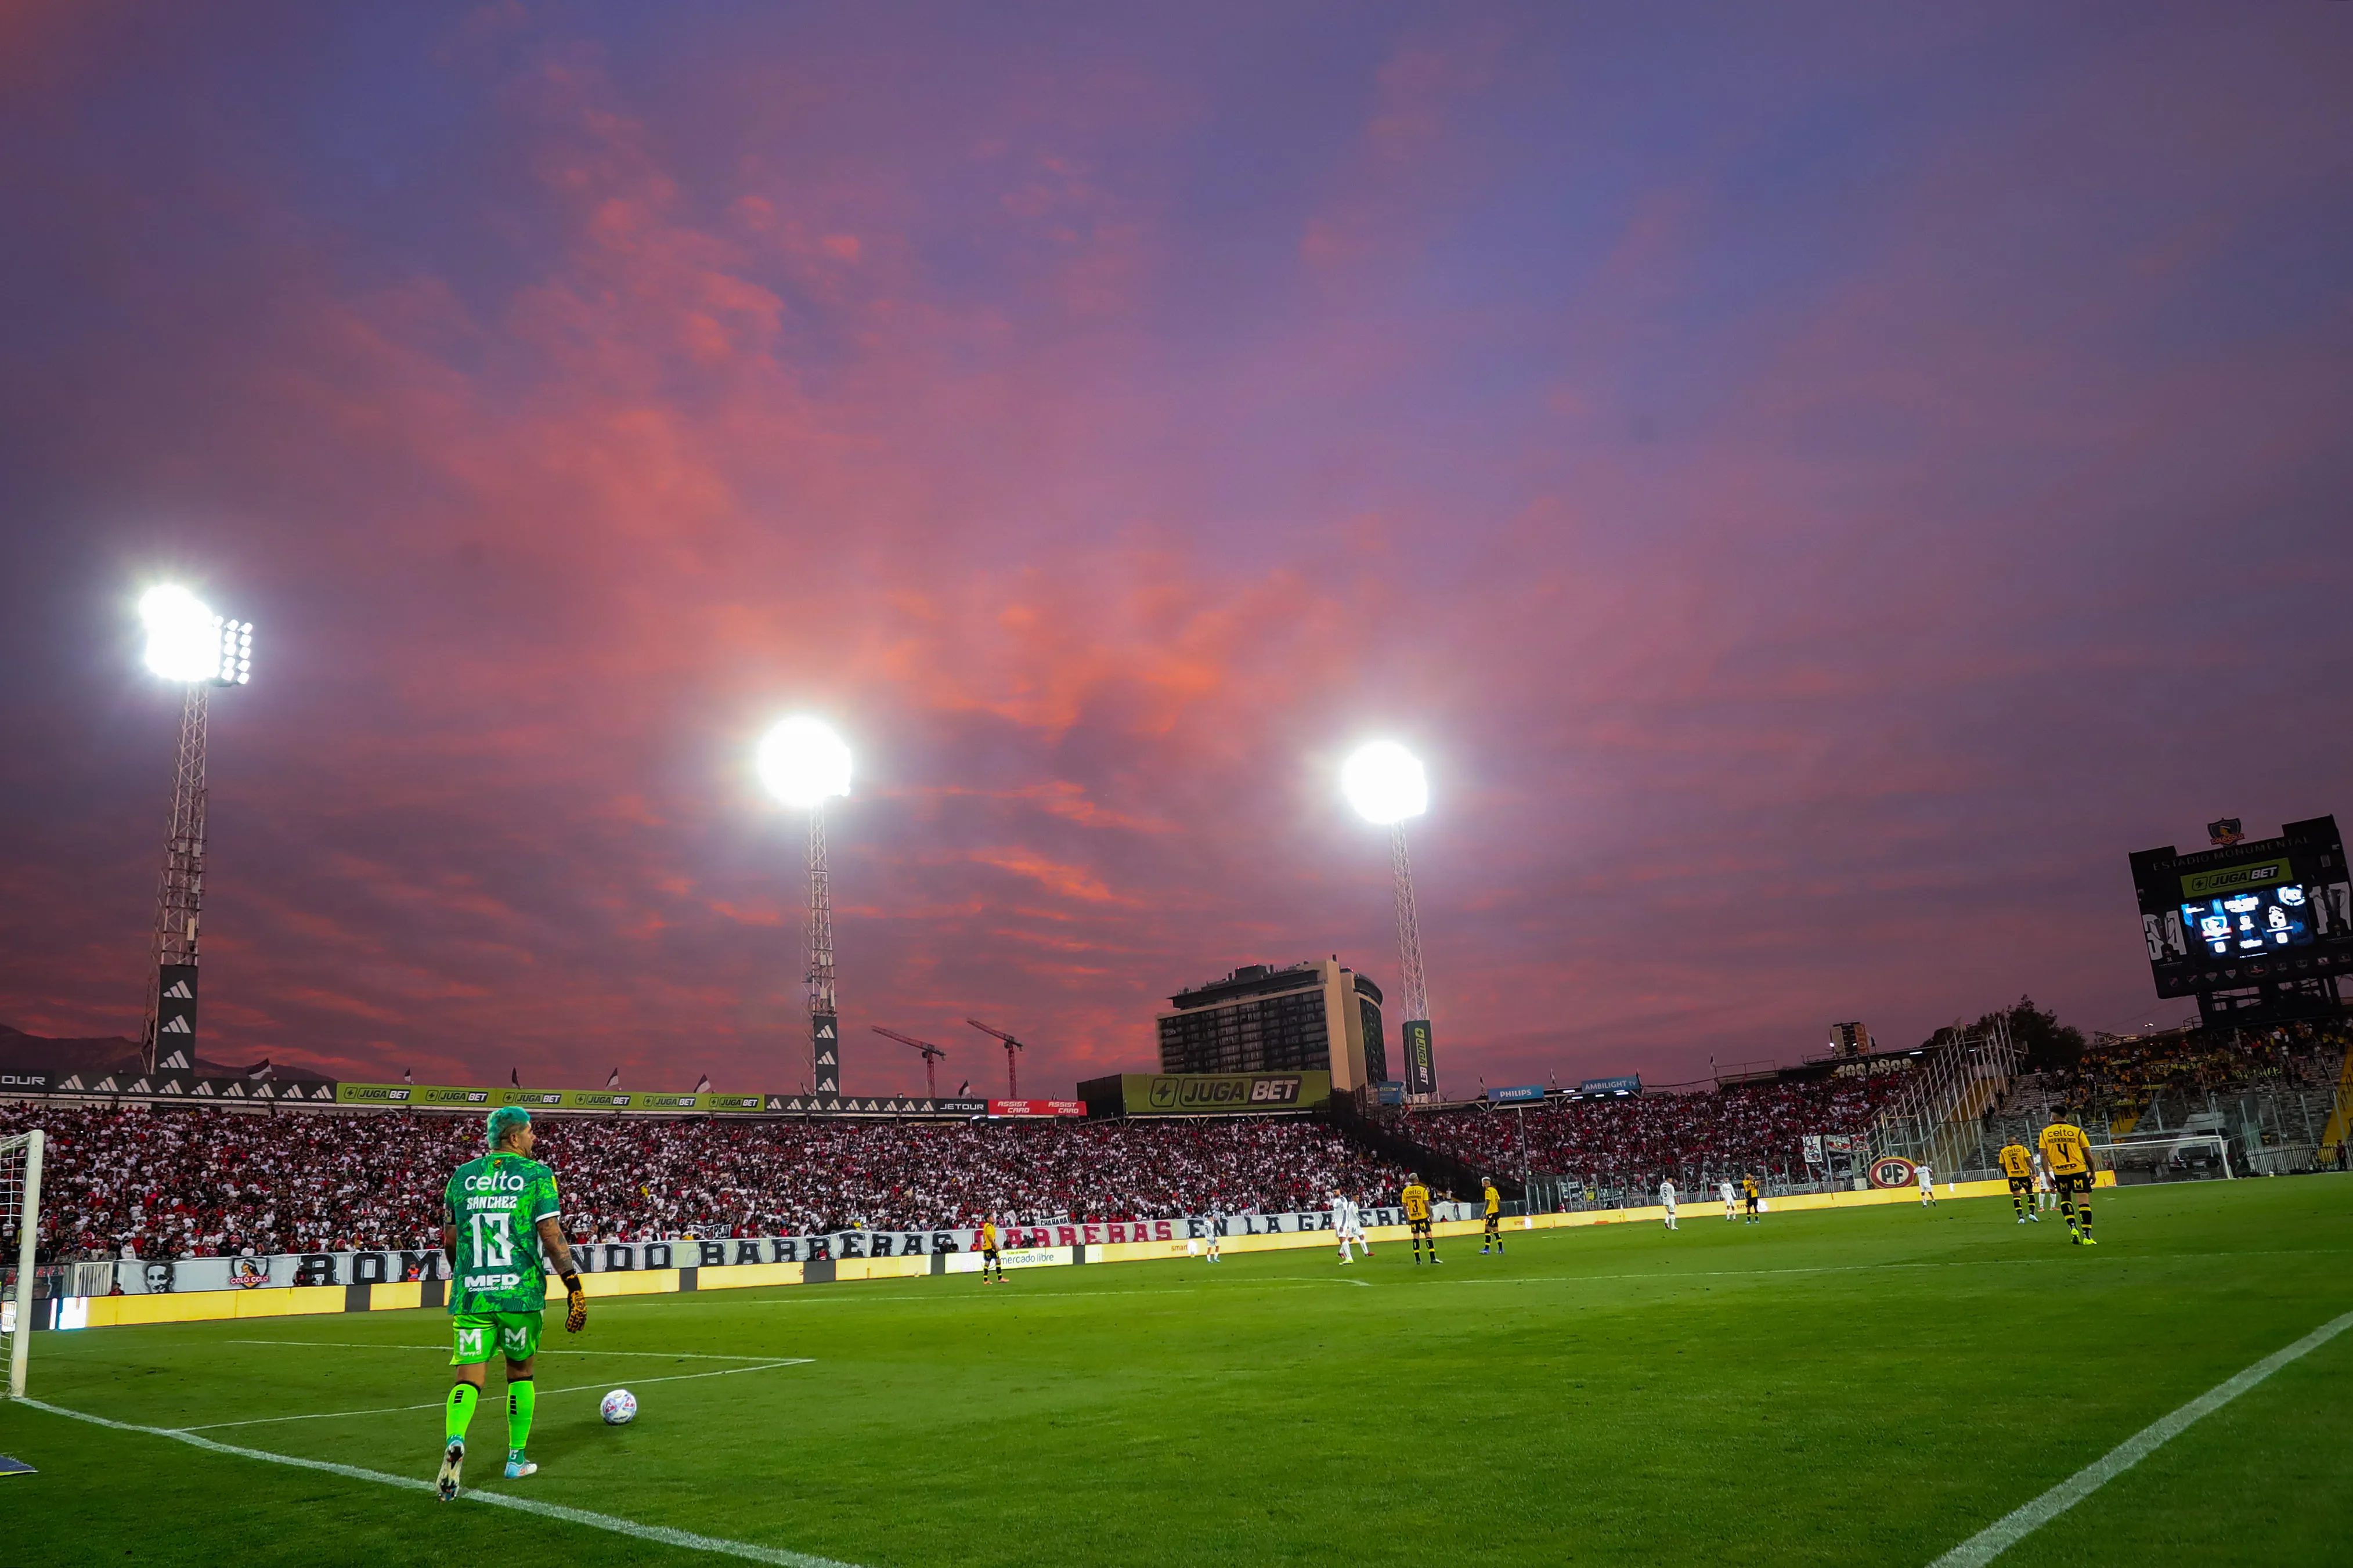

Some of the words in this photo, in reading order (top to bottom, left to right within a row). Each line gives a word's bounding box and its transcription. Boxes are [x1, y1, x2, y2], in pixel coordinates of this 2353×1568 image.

[2152, 855, 2209, 871] ESTADIO
[2214, 836, 2310, 860] MONUMENTAL
[1835, 1063, 1867, 1079] 100
[1868, 1058, 1913, 1075] AÑOS
[1, 1075, 45, 1085] OUR
[1585, 1080, 1627, 1091] AMBILIGHT
[1500, 1089, 1532, 1098] PHILIPS
[2047, 1129, 2074, 1137] celta
[2056, 1143, 2070, 1163] 4
[2011, 1157, 2020, 1169] 6
[465, 1170, 525, 1191] celta
[1881, 1164, 1904, 1183] PF
[1411, 1199, 1418, 1212] 3
[1245, 1215, 1283, 1235] LA
[469, 1212, 515, 1269] 13
[1000, 1254, 1035, 1264] mercado
[1037, 1252, 1054, 1262] libre
[464, 1274, 520, 1288] MFD
